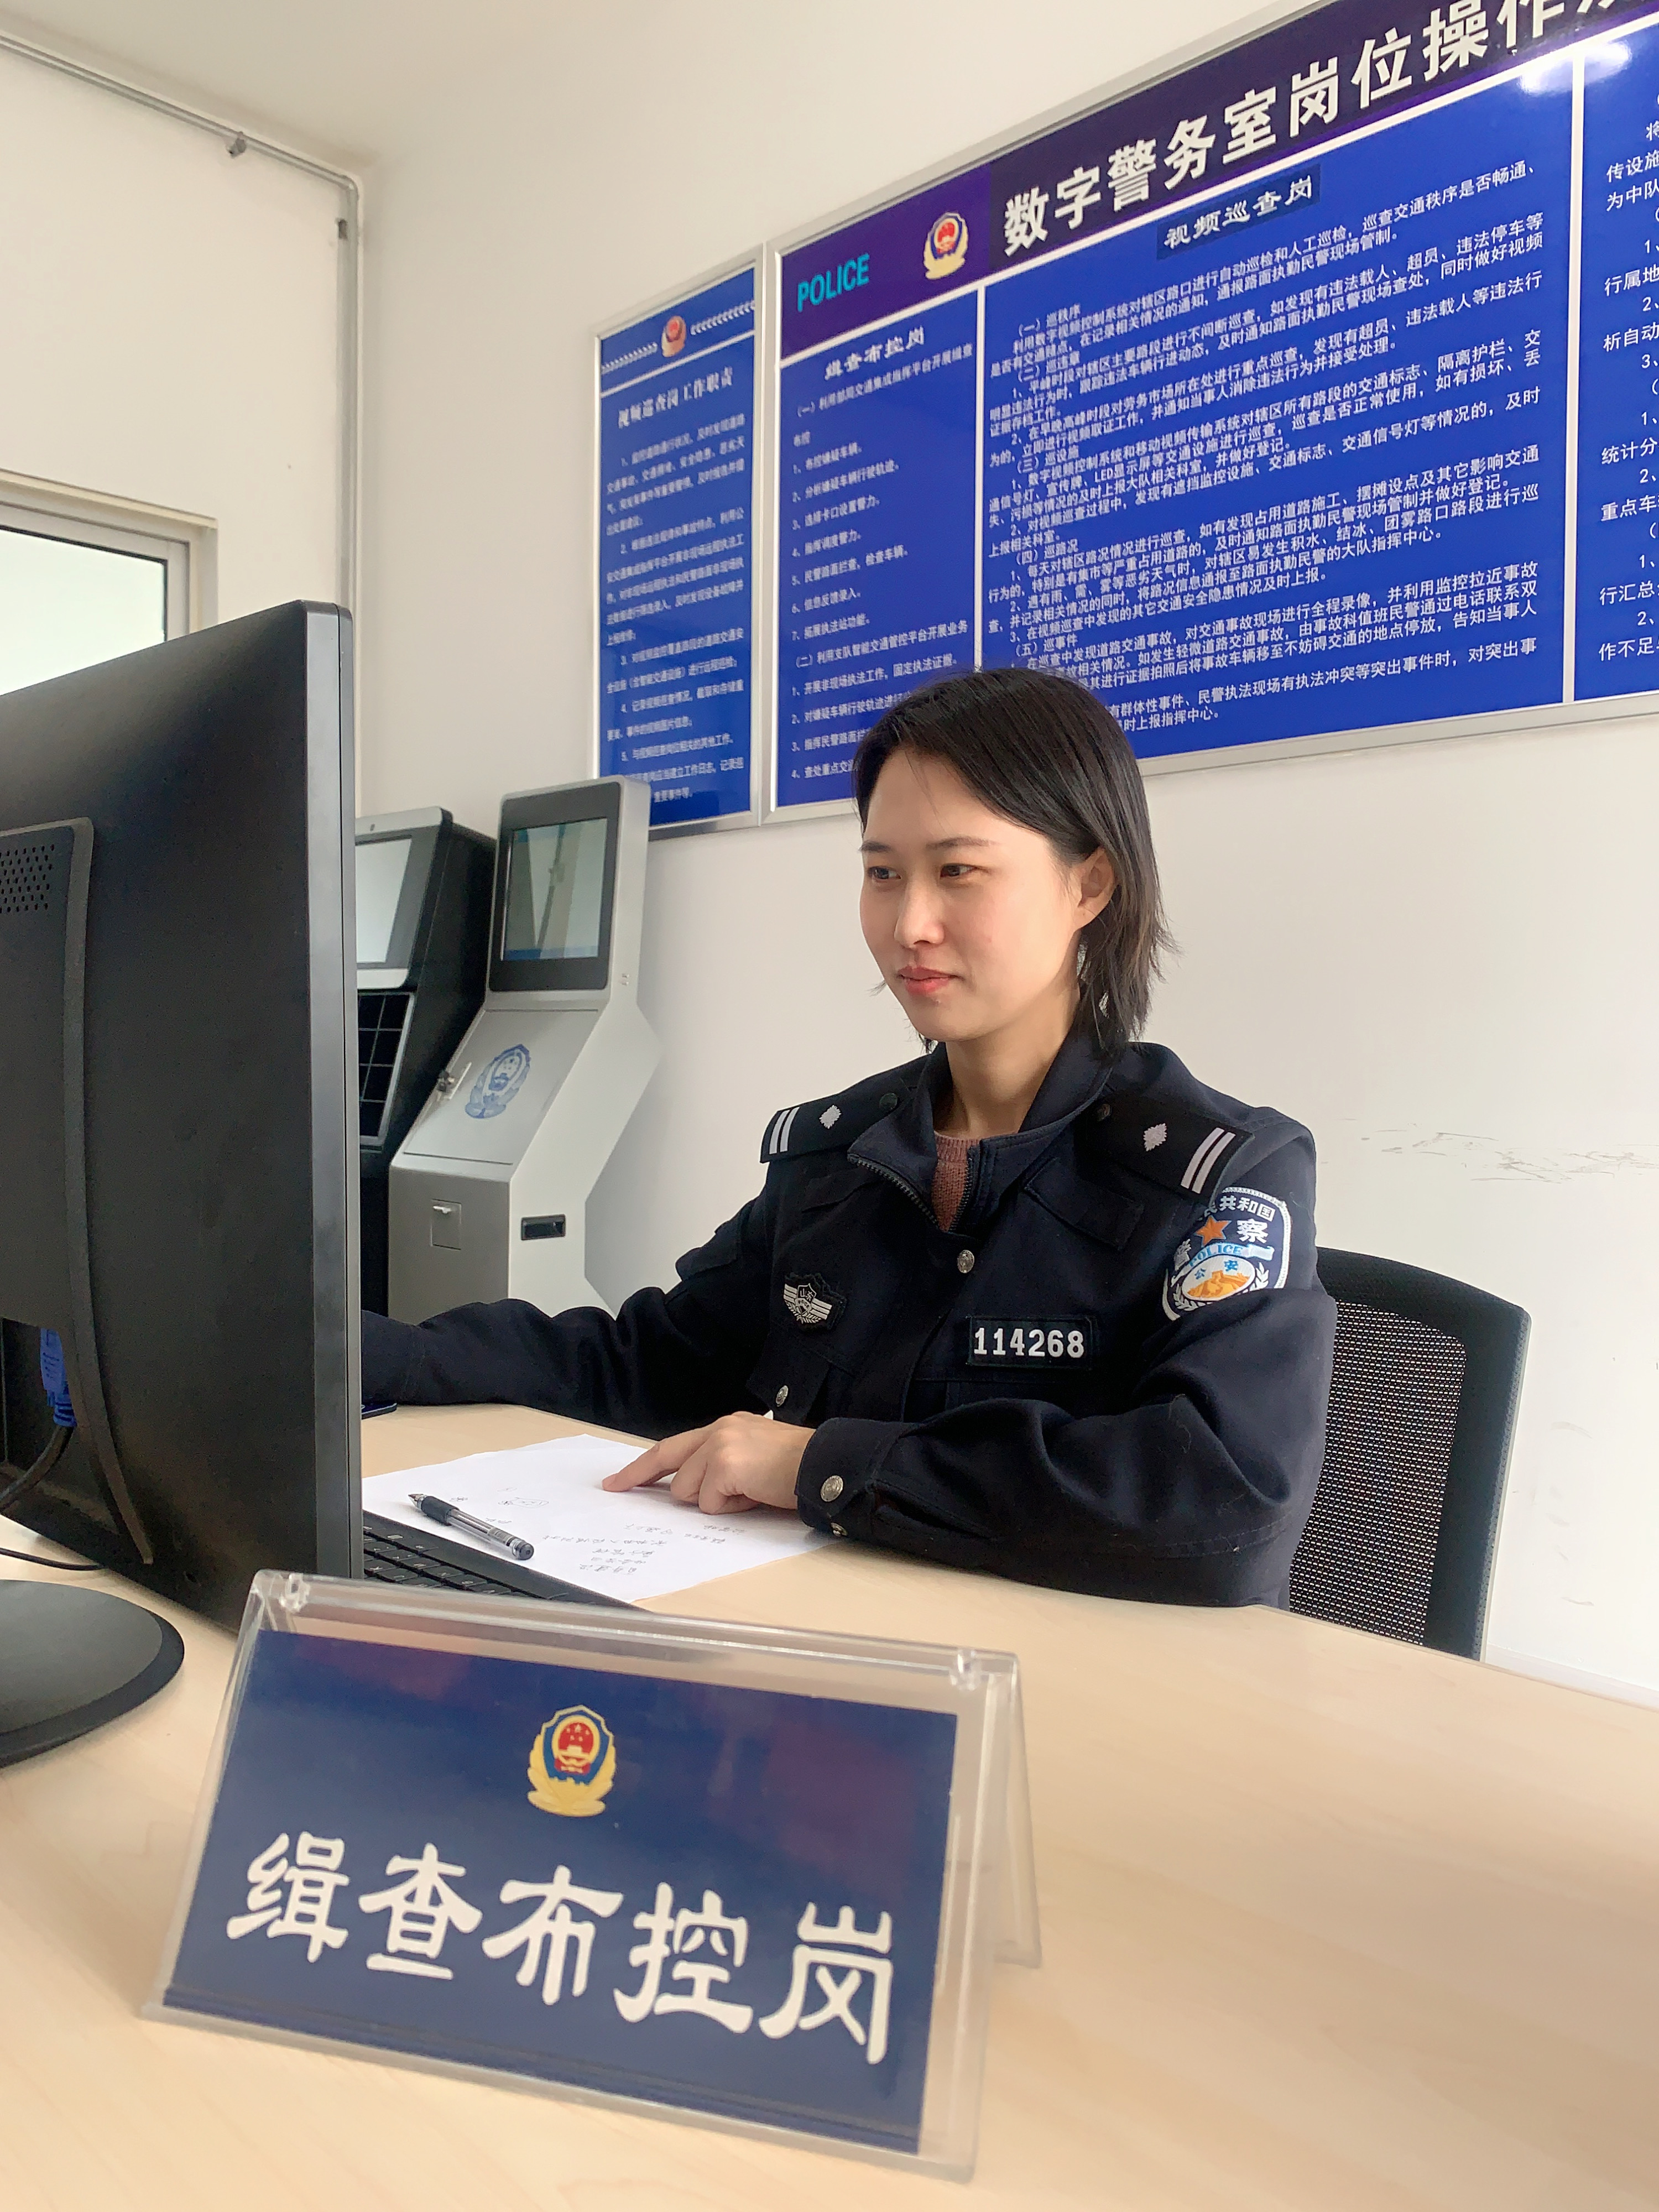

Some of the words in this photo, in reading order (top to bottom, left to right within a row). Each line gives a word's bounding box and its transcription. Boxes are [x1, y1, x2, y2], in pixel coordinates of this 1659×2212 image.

[1003, 0, 1623, 257] 数字警务室岗位操作
[1165, 173, 1312, 252] 视频巡查岗
[796, 253, 870, 312] POLICE
[1604, 264, 1659, 297] 行属地
[1601, 437, 1659, 465] 统计分
[1601, 494, 1659, 521] 重点车
[1600, 580, 1659, 606] 行汇总
[1015, 632, 1077, 658] （五）巡事件
[1599, 636, 1659, 661] 作不足
[1116, 705, 1220, 734] 时上报指挥中心。
[973, 1327, 1084, 1358] 114268
[227, 1830, 893, 2065] 缉查布控岗
